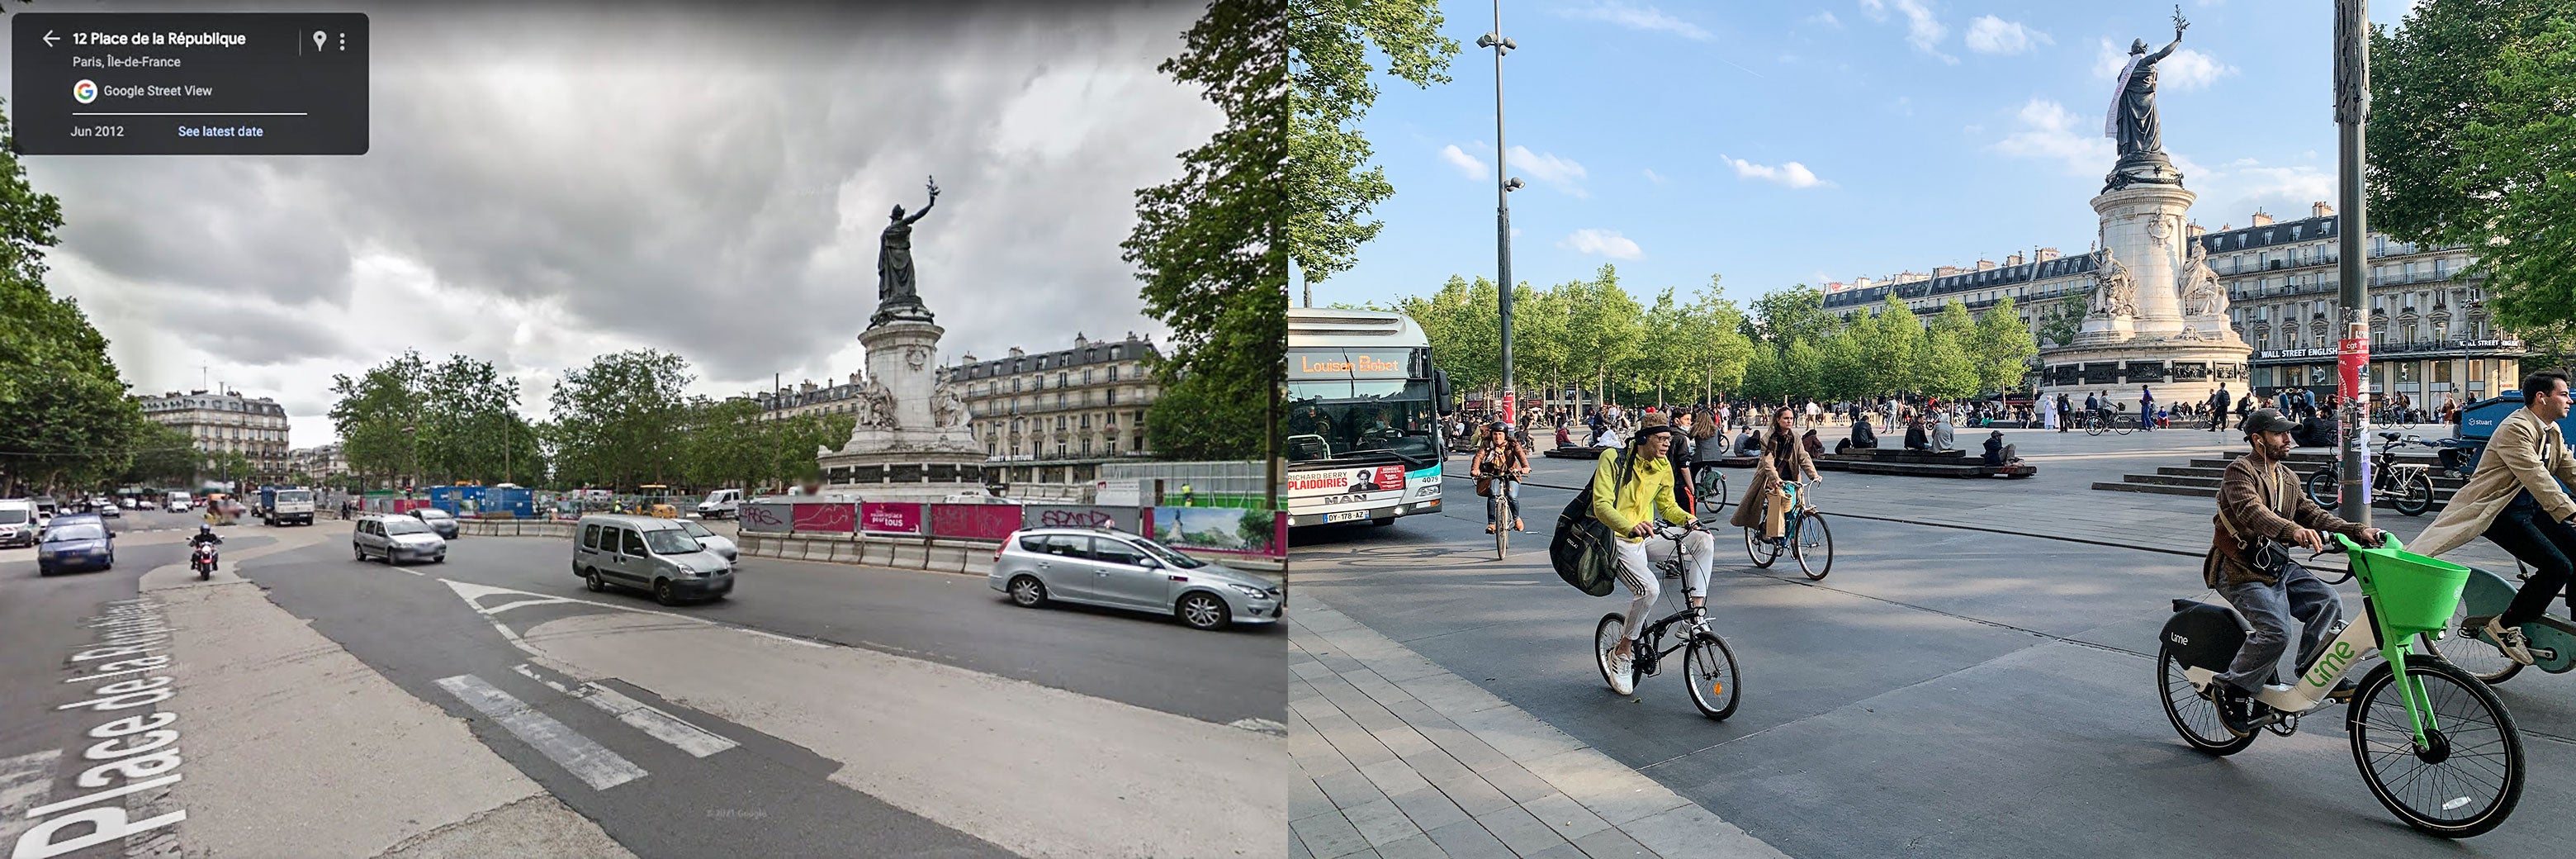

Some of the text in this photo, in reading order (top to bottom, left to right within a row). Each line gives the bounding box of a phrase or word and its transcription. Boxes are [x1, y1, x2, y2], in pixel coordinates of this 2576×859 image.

[2308, 347, 2337, 355] ENGLISH
[1302, 355, 1399, 373] Louison Bobet
[1288, 477, 1347, 491] PLAIDOIRIES
[1324, 494, 1367, 505] MAN
[885, 518, 903, 527] tous
[2171, 632, 2188, 646] Lime
[2304, 641, 2356, 688] Lime
[57, 676, 177, 710] de
[12, 712, 187, 859] Place
